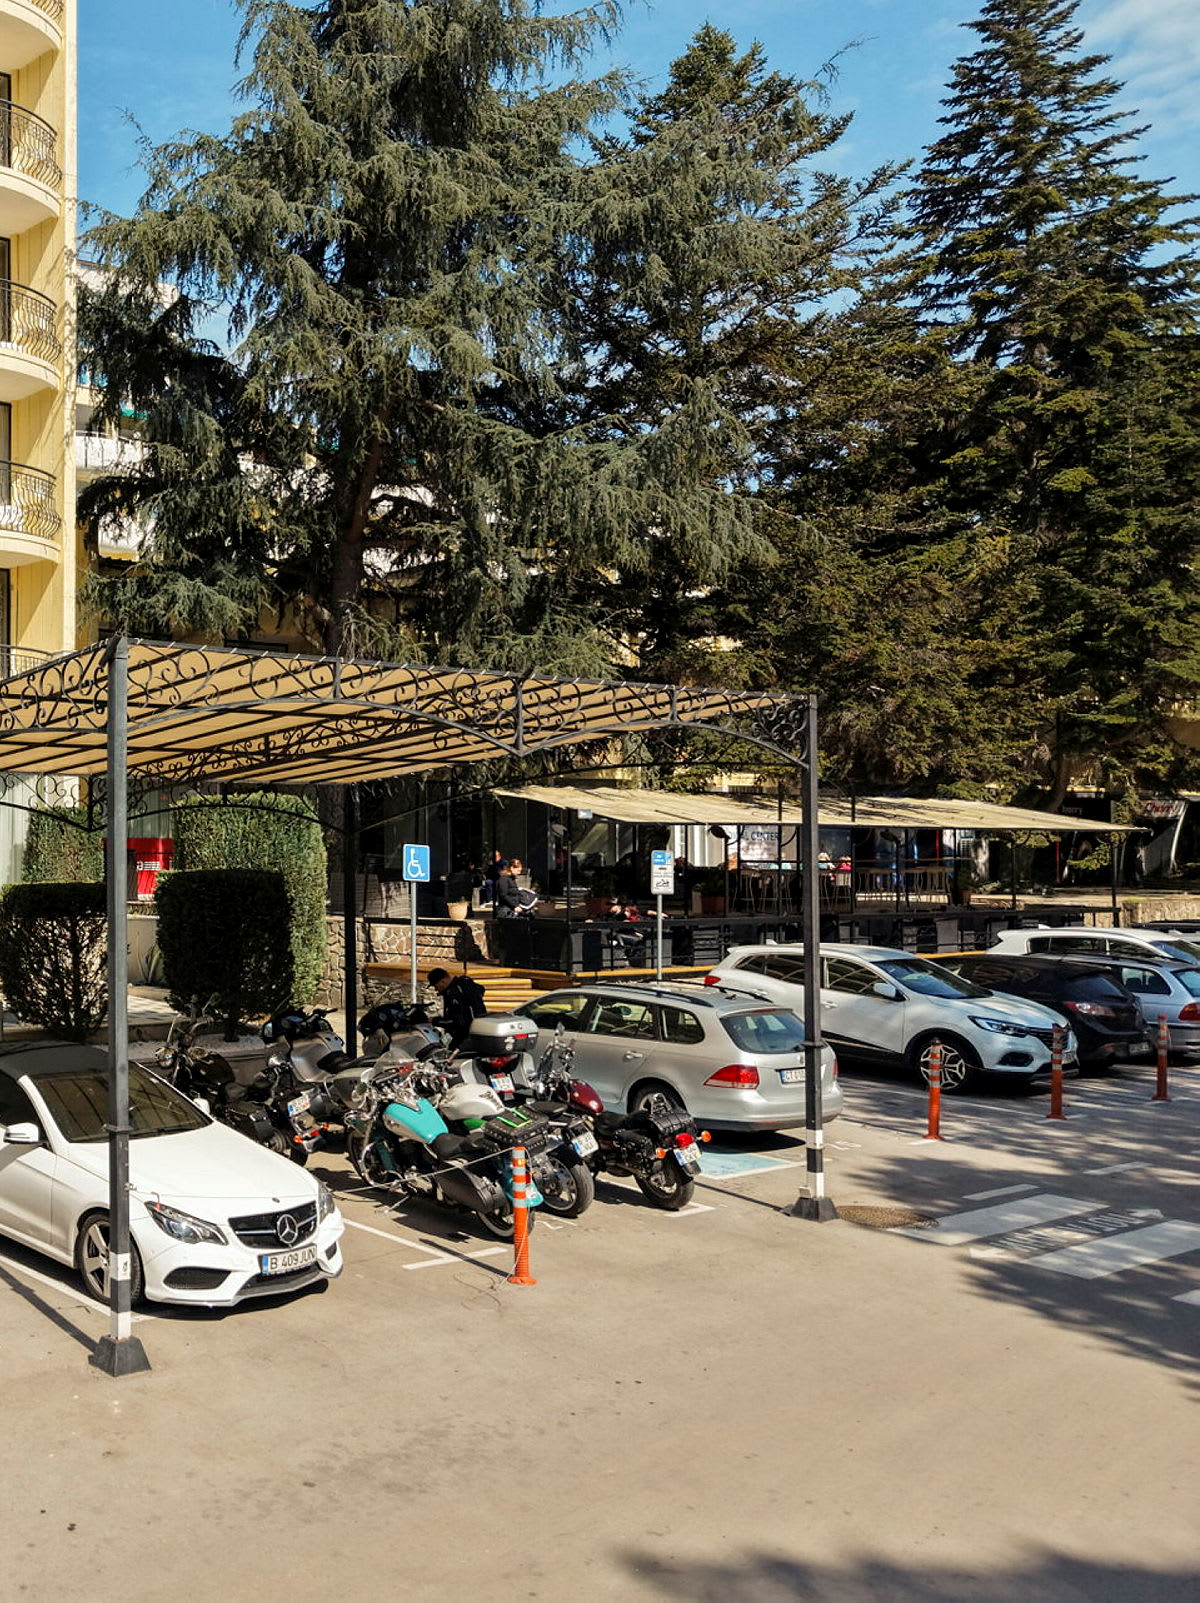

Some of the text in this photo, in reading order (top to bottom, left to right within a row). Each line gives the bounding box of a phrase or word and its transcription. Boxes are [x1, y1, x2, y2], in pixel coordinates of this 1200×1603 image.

[270, 1247, 316, 1270] B 409 JUN
